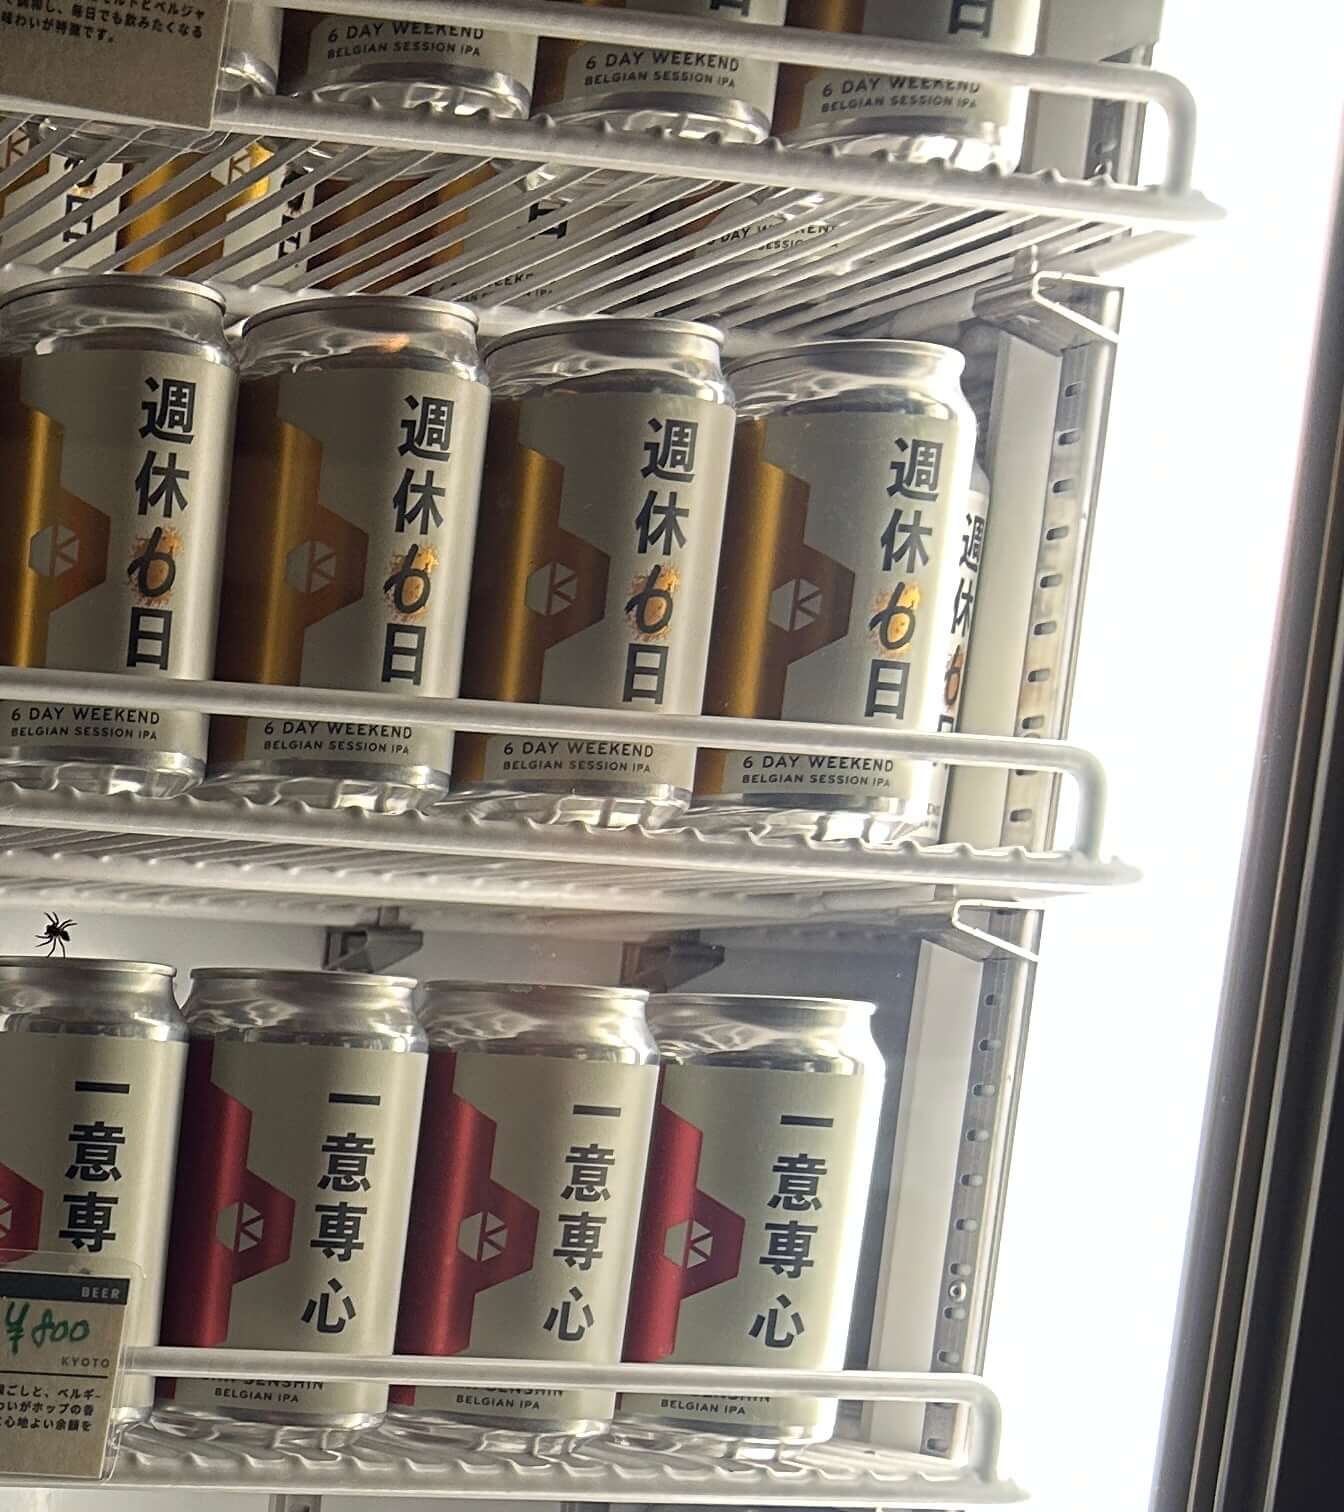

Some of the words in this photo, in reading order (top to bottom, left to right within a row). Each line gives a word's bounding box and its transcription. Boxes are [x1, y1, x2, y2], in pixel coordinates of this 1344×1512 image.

[328, 28, 337, 42] 6
[346, 23, 384, 39] DAY
[392, 22, 483, 39] WEEKEND
[327, 42, 387, 58] BELGIAN
[394, 42, 449, 55] SESSION
[455, 44, 480, 56] IPA
[586, 56, 596, 70] 6
[605, 52, 643, 68] DAY
[652, 51, 739, 72] WEEKEND
[584, 72, 648, 86] BELGIAN
[654, 70, 712, 84] SESSION
[718, 75, 735, 88] IPA
[822, 83, 832, 97] 6
[842, 77, 880, 94] DAY
[889, 76, 980, 94] WEEKEND
[822, 97, 883, 112] BELGIAN
[891, 96, 952, 109] SESSION
[957, 97, 976, 109] IPA
[12, 708, 21, 720] 6
[29, 708, 64, 720] DAY
[73, 708, 160, 725] WEEKEND
[11, 726, 69, 738] BELGIAN
[74, 727, 131, 739] SESSION
[139, 729, 157, 740] IPA
[264, 721, 273, 735] 6
[282, 722, 319, 735] DAY
[327, 721, 412, 739] WEEKEND
[264, 741, 323, 752] BELGIAN
[328, 740, 387, 754] SESSION
[392, 743, 409, 755] IPA
[504, 743, 514, 756] 6
[522, 743, 558, 756] DAY
[566, 742, 654, 758] WEEKEND
[504, 760, 559, 772] BELGIAN
[564, 761, 627, 773] SESSION
[632, 763, 650, 774] IPA
[743, 755, 753, 769] 6
[762, 756, 800, 769] DAY
[808, 756, 893, 772] WEEKEND
[742, 774, 804, 784] BELGIAN
[809, 774, 868, 786] SESSION
[873, 776, 890, 788] IPA
[58, 1080, 131, 1254] 一意専
[300, 1091, 381, 1336] 一意専心
[543, 1103, 622, 1343] 一意専心
[749, 1112, 835, 1349] 一意専心
[81, 1285, 121, 1300] BEER
[4, 1300, 90, 1355] ¥800
[60, 1355, 110, 1370] KYOTO
[214, 1388, 273, 1402] BELGIAN
[278, 1391, 299, 1403] IPA
[456, 1394, 515, 1408] BELGIAN
[519, 1398, 540, 1410] IPA
[660, 1398, 718, 1413] BELGIAN
[724, 1404, 746, 1414] IPA
